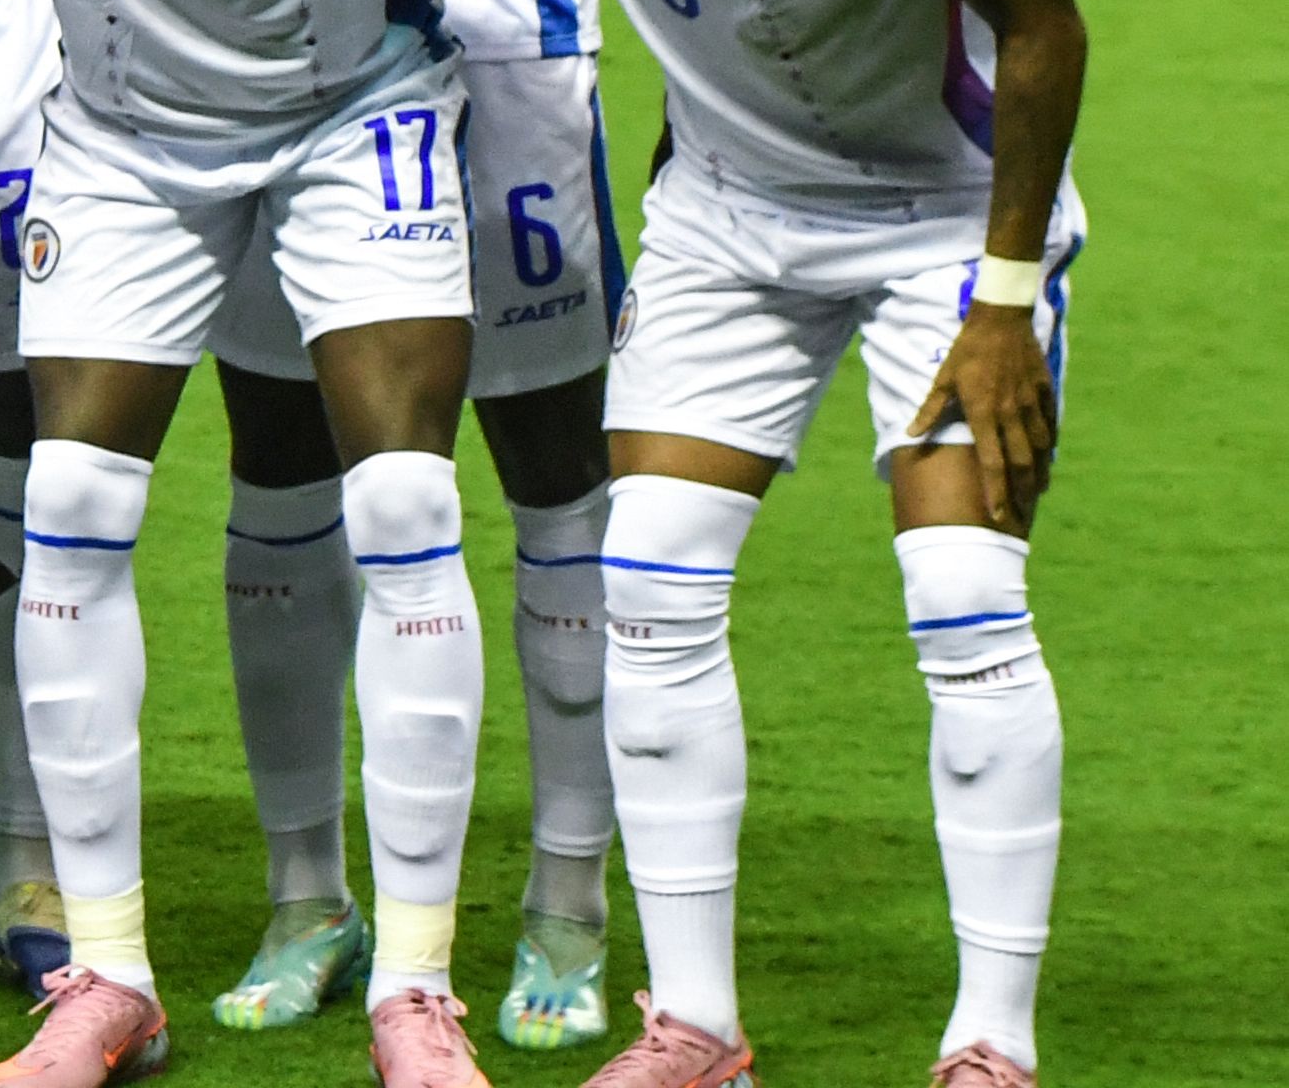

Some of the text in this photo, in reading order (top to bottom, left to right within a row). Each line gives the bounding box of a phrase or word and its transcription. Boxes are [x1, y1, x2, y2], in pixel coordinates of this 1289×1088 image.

[364, 109, 436, 211] 17
[359, 223, 454, 242] SAETA
[507, 182, 562, 287] 6
